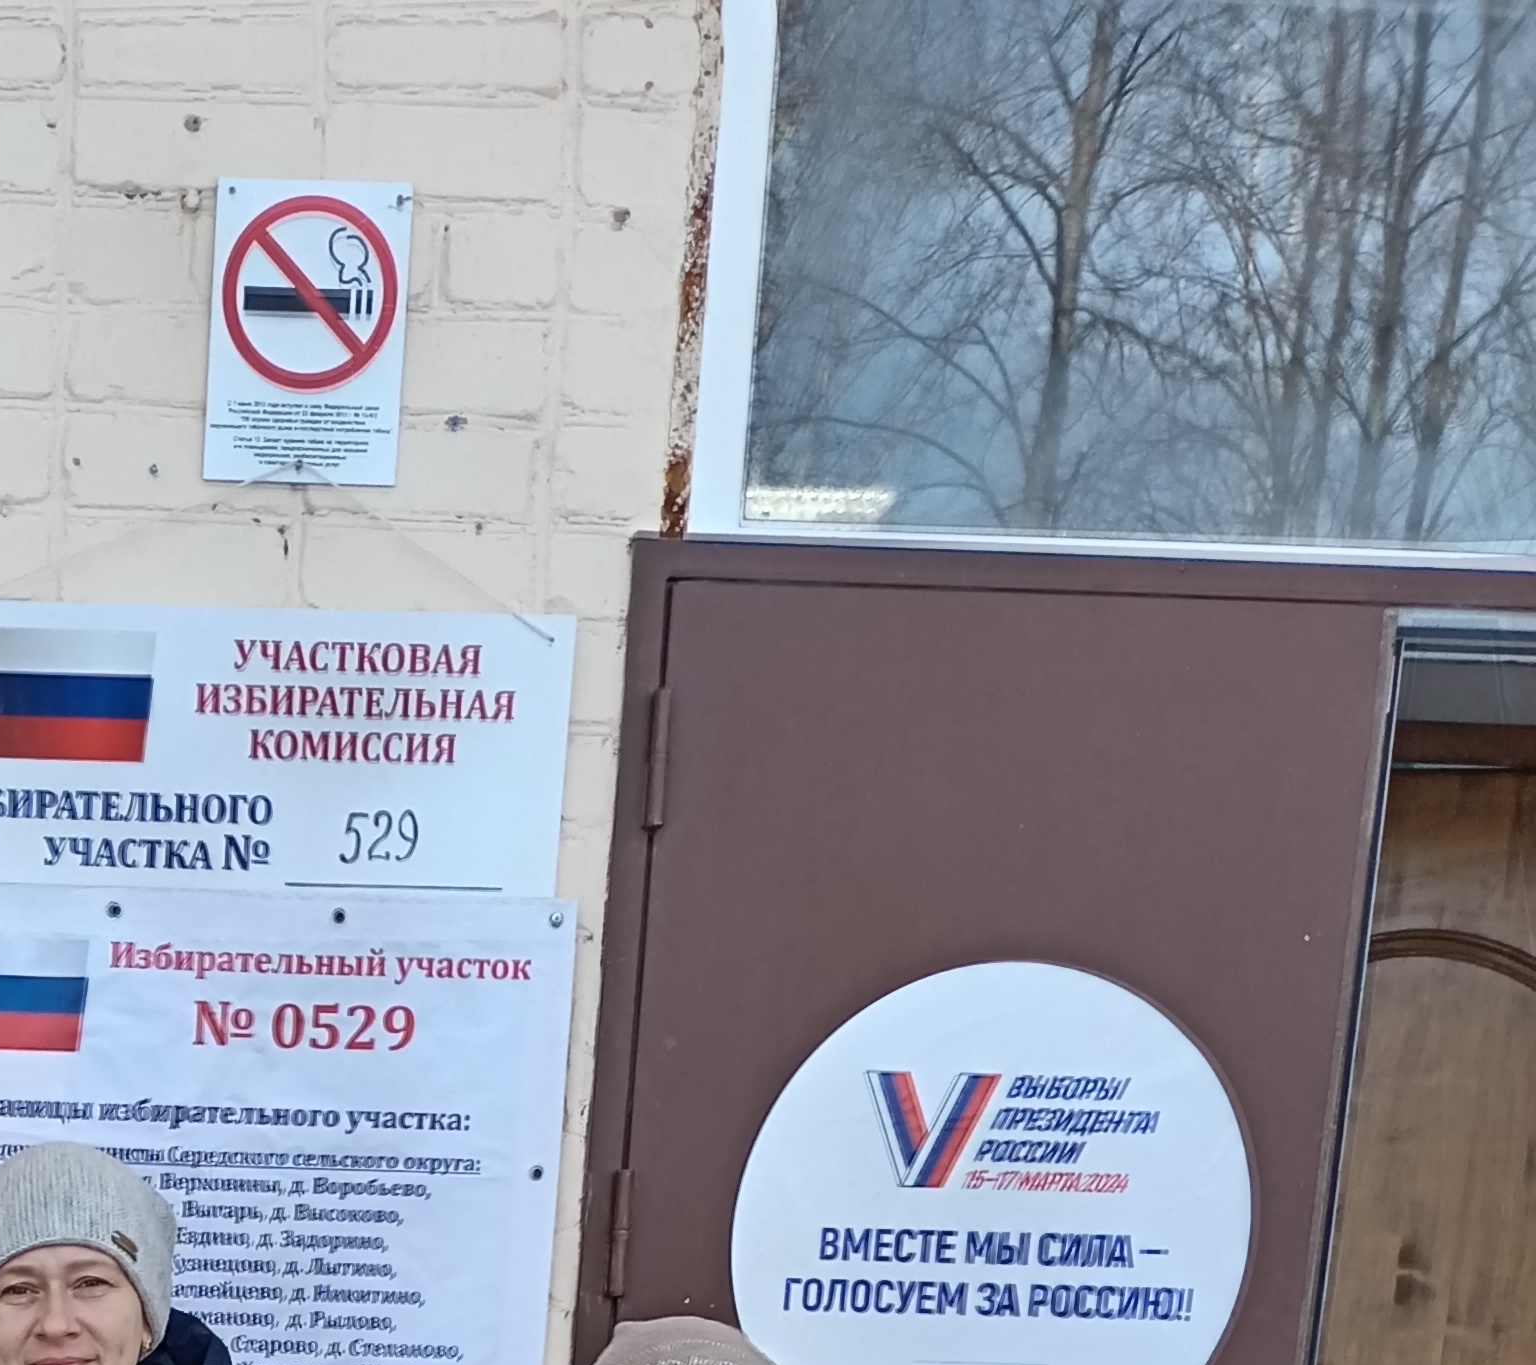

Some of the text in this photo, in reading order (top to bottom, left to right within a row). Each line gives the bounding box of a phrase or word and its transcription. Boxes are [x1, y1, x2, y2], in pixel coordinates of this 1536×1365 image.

[233, 638, 482, 677] УЧАСТКОВАЯ
[194, 683, 516, 722] ИЗБИРАТЕЛЬНАЯ
[248, 728, 456, 765] КОМИССИЯ
[43, 809, 420, 871] УЧАСТКА № 529
[109, 940, 532, 985] Избирательный участок
[191, 1000, 415, 1051] № 0529
[1006, 1075, 1132, 1101] ВЫБОРЫ
[98, 1098, 340, 1129] избирательного
[345, 1109, 471, 1134] участка:
[990, 1107, 1161, 1136] ПРЕЗИДЕНТА
[167, 1145, 289, 1168] Середского
[292, 1152, 399, 1169] сельского
[403, 1156, 481, 1175] округа:
[973, 1140, 1088, 1164] РОССИИ
[159, 1172, 286, 1196] Верховины,
[288, 1180, 309, 1197] д.
[313, 1177, 432, 1200] Воробьево,
[1078, 1172, 1130, 1194] 2024
[269, 1207, 291, 1224] д.
[293, 1204, 404, 1225] Высоково,
[255, 1233, 278, 1250] д.
[280, 1230, 389, 1253] Задорино,
[818, 1227, 959, 1265] ВМЕСТЕ
[965, 1230, 1031, 1266] МЫ
[1037, 1232, 1134, 1268] СИЛА
[172, 1254, 281, 1277] узнецово,
[282, 1260, 304, 1277] д.
[171, 1280, 287, 1303] атвейцево,
[288, 1286, 310, 1305] д.
[782, 1277, 968, 1316] ГОЛОСУЕМ
[975, 1282, 1021, 1317] ЗА
[284, 1313, 308, 1331] д.
[230, 1334, 323, 1358] Старово,
[324, 1341, 346, 1359] д.
[349, 1338, 464, 1362] Степаново,
